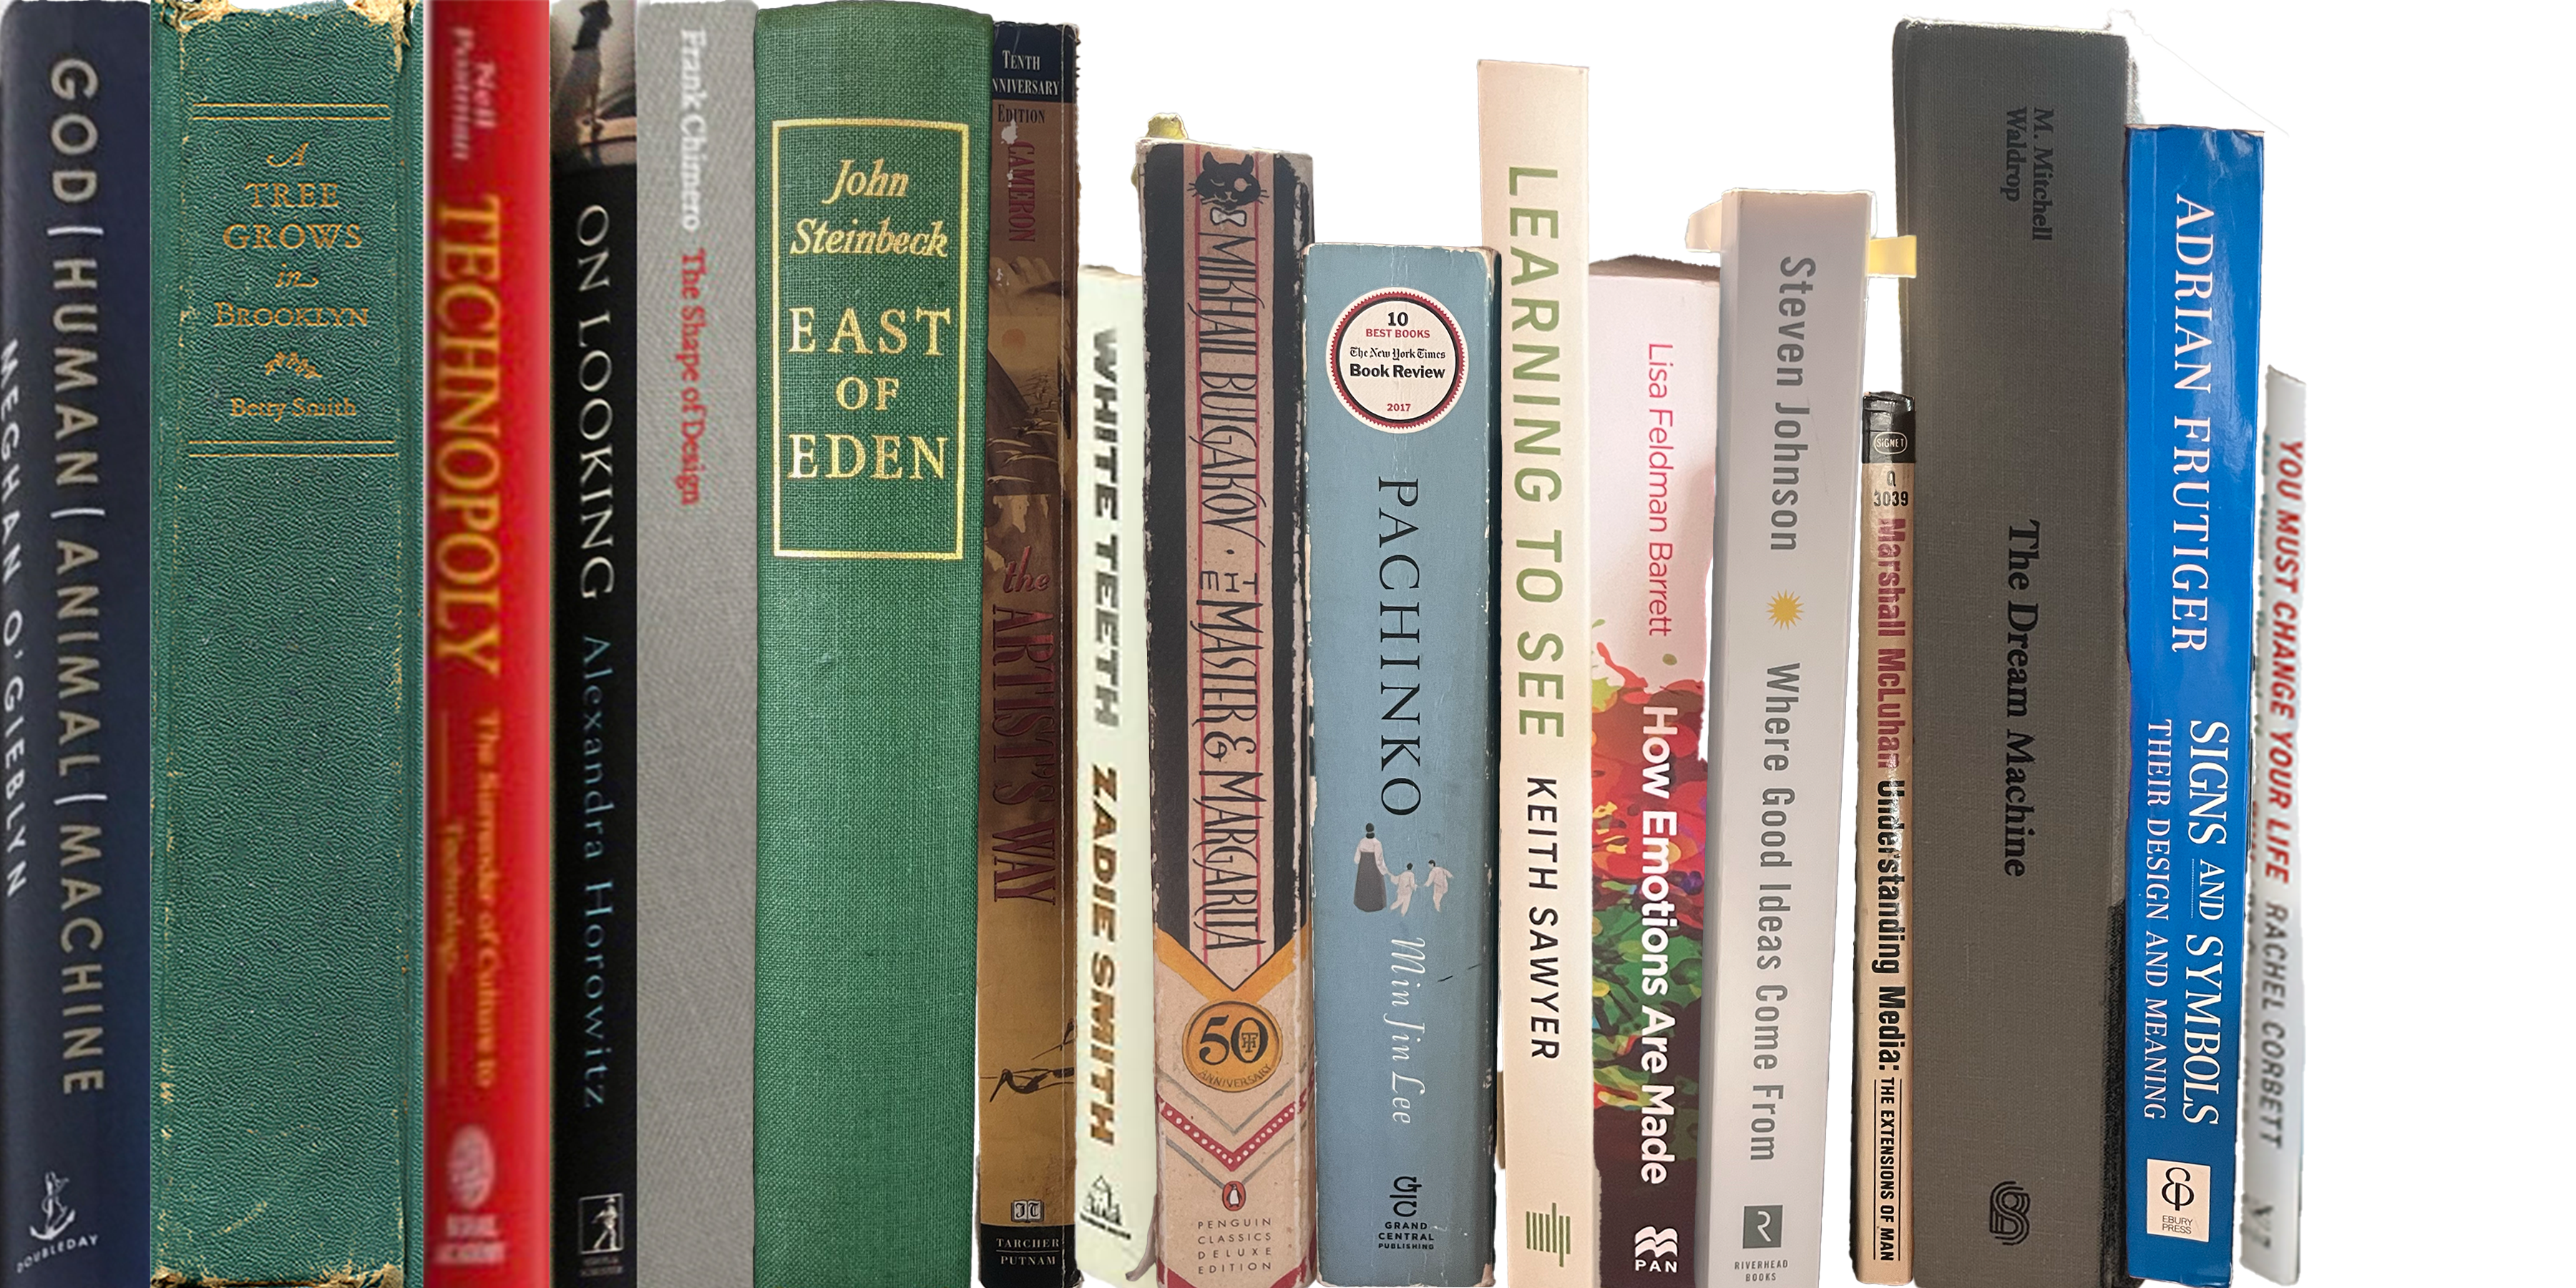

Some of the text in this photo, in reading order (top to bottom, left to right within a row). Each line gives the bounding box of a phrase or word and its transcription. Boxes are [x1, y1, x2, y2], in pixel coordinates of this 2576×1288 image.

[1002, 49, 1040, 70] TENTH
[992, 78, 1059, 95] NNIVERSARY
[998, 104, 1045, 123] EDITION
[267, 142, 308, 167] A
[2000, 107, 2027, 203] Waldrop
[2032, 108, 2054, 241] M. Mitchell
[245, 182, 338, 208] TREE
[821, 160, 909, 205] John
[1008, 140, 1035, 242] CAMERON
[223, 223, 363, 249] GROWS
[790, 219, 949, 258] Steinbeck
[275, 264, 320, 288] in
[675, 29, 707, 504] Frank Chimero The Shape of Design
[214, 303, 369, 327] BROOKLYN
[1188, 233, 1265, 367] MIKHAIL
[1387, 312, 1409, 326] 10
[789, 308, 951, 356] EAST
[1350, 346, 1445, 361] The New York Times
[1366, 328, 1430, 338] BEST BOOKS
[1350, 364, 1445, 378] Book Review
[230, 396, 356, 420] Betty Smith
[836, 377, 899, 411] OF
[435, 195, 502, 678] TECHNOPOLY
[2172, 194, 2214, 652] ADRIAN FRUTIGER
[0, 339, 21, 584] MEGHAN
[789, 434, 947, 479] EDEN
[1189, 371, 1267, 547] BULGAKOV
[1649, 343, 1674, 637] Lisa Feldman Barrett
[1873, 490, 1908, 507] 3039
[50, 58, 104, 1094] GOD HUMAN ANIMAL MACHINE
[1004, 545, 1050, 593] the
[1508, 166, 1564, 1059] LEARNING TO SEE KEITH SAWYER
[577, 205, 615, 1108] ON LOOKING Alexandra Horowitz
[1189, 600, 1264, 728] MASTER
[1378, 477, 1422, 816] PACHINKO
[1750, 255, 1816, 1161] Steven Johnson Where Good Ideas Come From
[2004, 521, 2040, 877] The Dream Machine
[992, 604, 1055, 906] ARTIST'S WAY
[1090, 329, 1119, 1146] WHITE TEETH ZADIE SMITH
[1203, 733, 1256, 761] &
[1871, 518, 1906, 1072] Marshall McLuhan Understanding Media:
[2259, 441, 2303, 1149] YOU MUST CHANGE YOUR LIFE RACHEL CORBETT
[1193, 771, 1267, 950] MARGARITA
[2144, 720, 2172, 1120] THEIR DESIGN AND MEANING
[2182, 719, 2230, 1126] SIGNS AND SYMBOLS
[1641, 707, 1679, 1185] How Emotions Are Made
[1199, 1015, 1269, 1065] 50
[1383, 937, 1425, 1123] Min Jin Lee
[1199, 1064, 1272, 1087] ANNIVERSARY
[1880, 1077, 1895, 1261] THE EXTENSIONS OF MAN
[996, 1238, 1059, 1248] TARCHER
[1198, 1218, 1271, 1229] PENGUIN
[1198, 1232, 1272, 1244] CLASSICS
[1378, 1232, 1434, 1241] CENTRAL
[2162, 1215, 2192, 1226] EBURY
[2162, 1224, 2191, 1234] PRESS
[16, 1234, 98, 1273] DOUBLEDAY
[1000, 1256, 1055, 1265] PUTNAM
[1198, 1262, 1271, 1274] EDITION
[1199, 1247, 1271, 1259] DELUXE
[1635, 1259, 1677, 1273] PAN
[1735, 1260, 1788, 1269] RIVERHEAD
